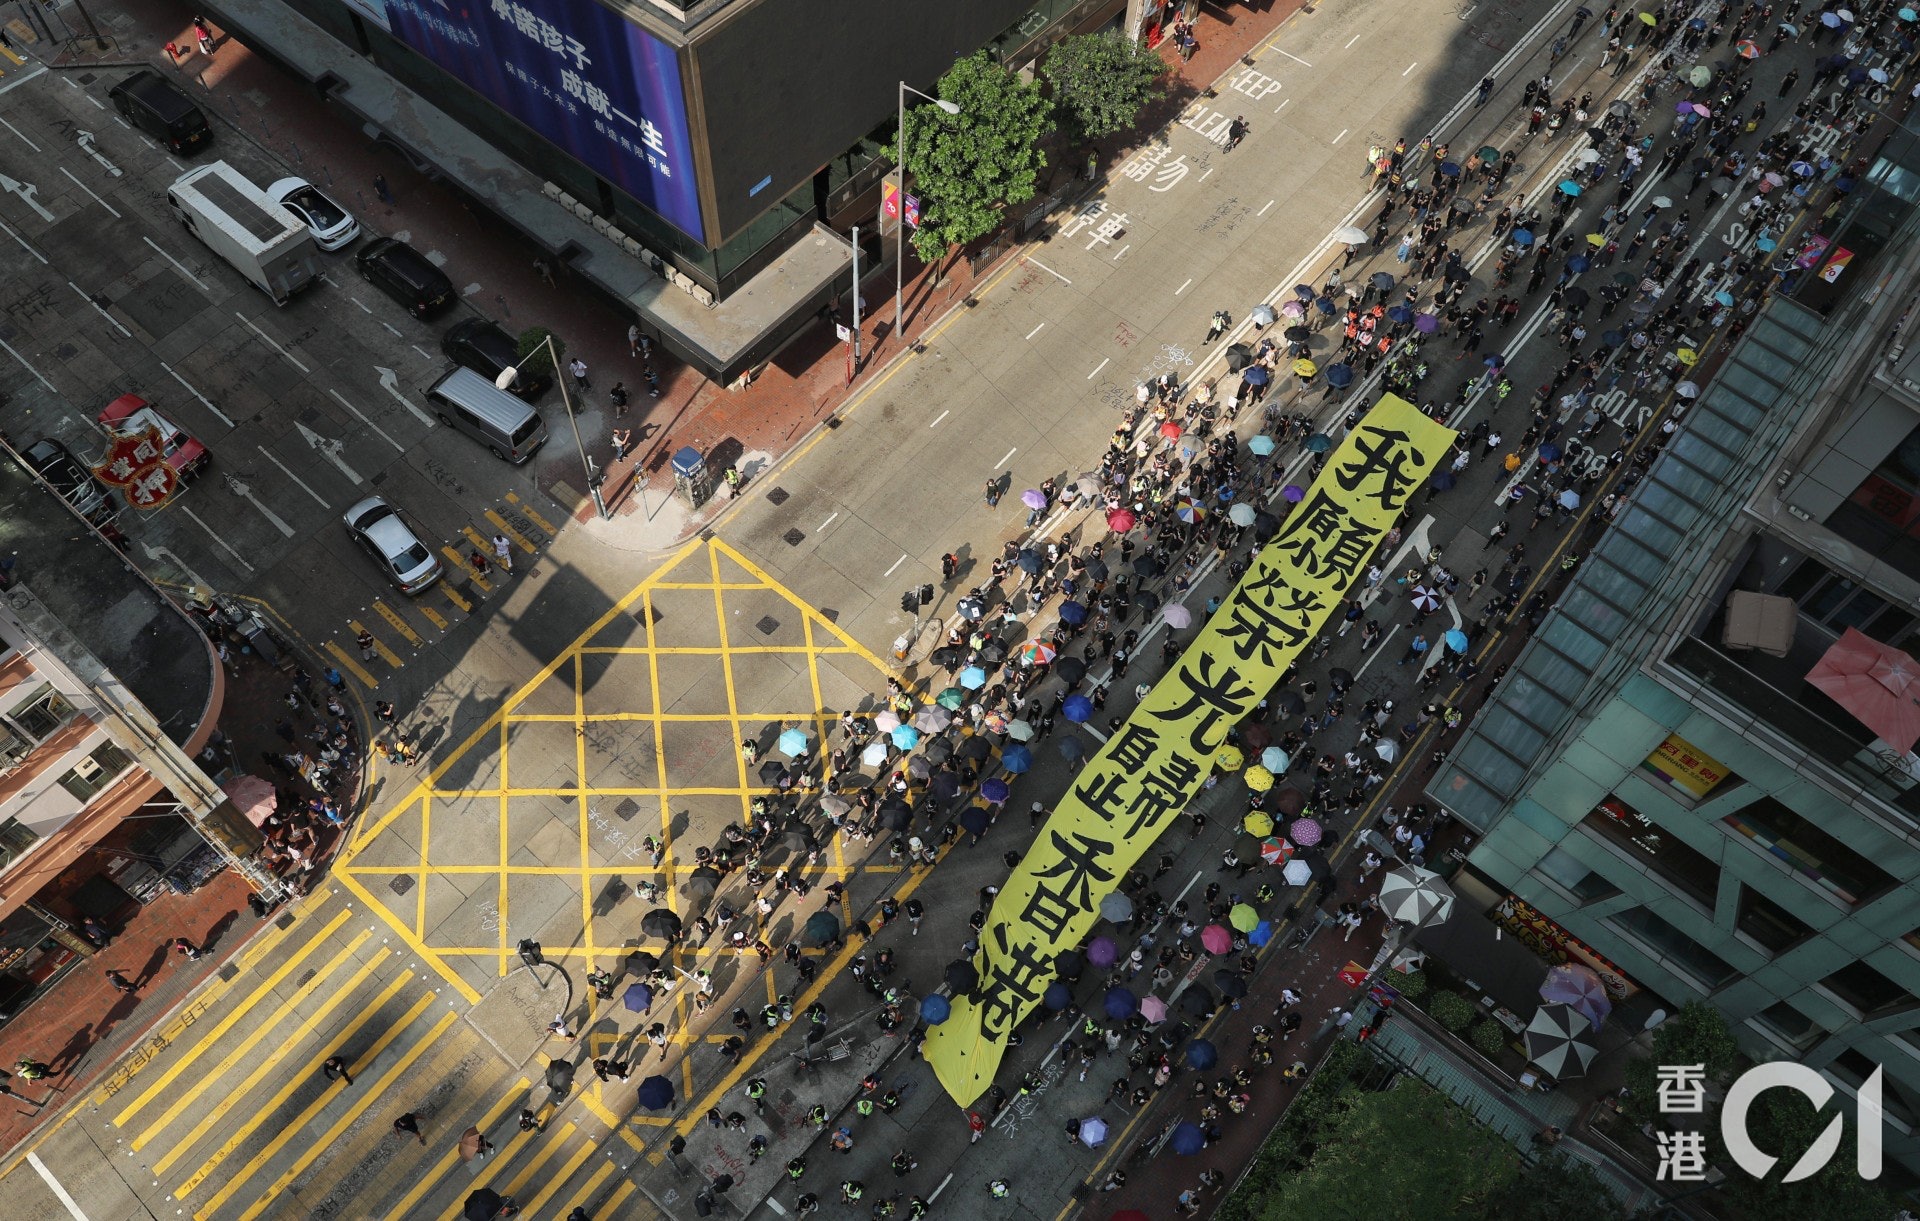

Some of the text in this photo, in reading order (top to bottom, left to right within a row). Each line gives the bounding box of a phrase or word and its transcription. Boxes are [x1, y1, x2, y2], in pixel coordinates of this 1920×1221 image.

[1228, 67, 1282, 101] KEEP
[560, 68, 668, 158] 成就一生
[593, 118, 672, 178] 創造無限可能
[1120, 143, 1190, 193] 請勿
[1058, 199, 1131, 251] 停車
[6, 282, 54, 317] FREE
[23, 293, 59, 321] HK
[1590, 385, 1654, 431] STOP
[134, 467, 168, 505] 押
[966, 424, 1430, 1045] 我願榮光歸香港
[1343, 973, 1356, 984] 70
[103, 1001, 208, 1099] 十月一賀佢老母
[314, 1196, 337, 1217] HK
